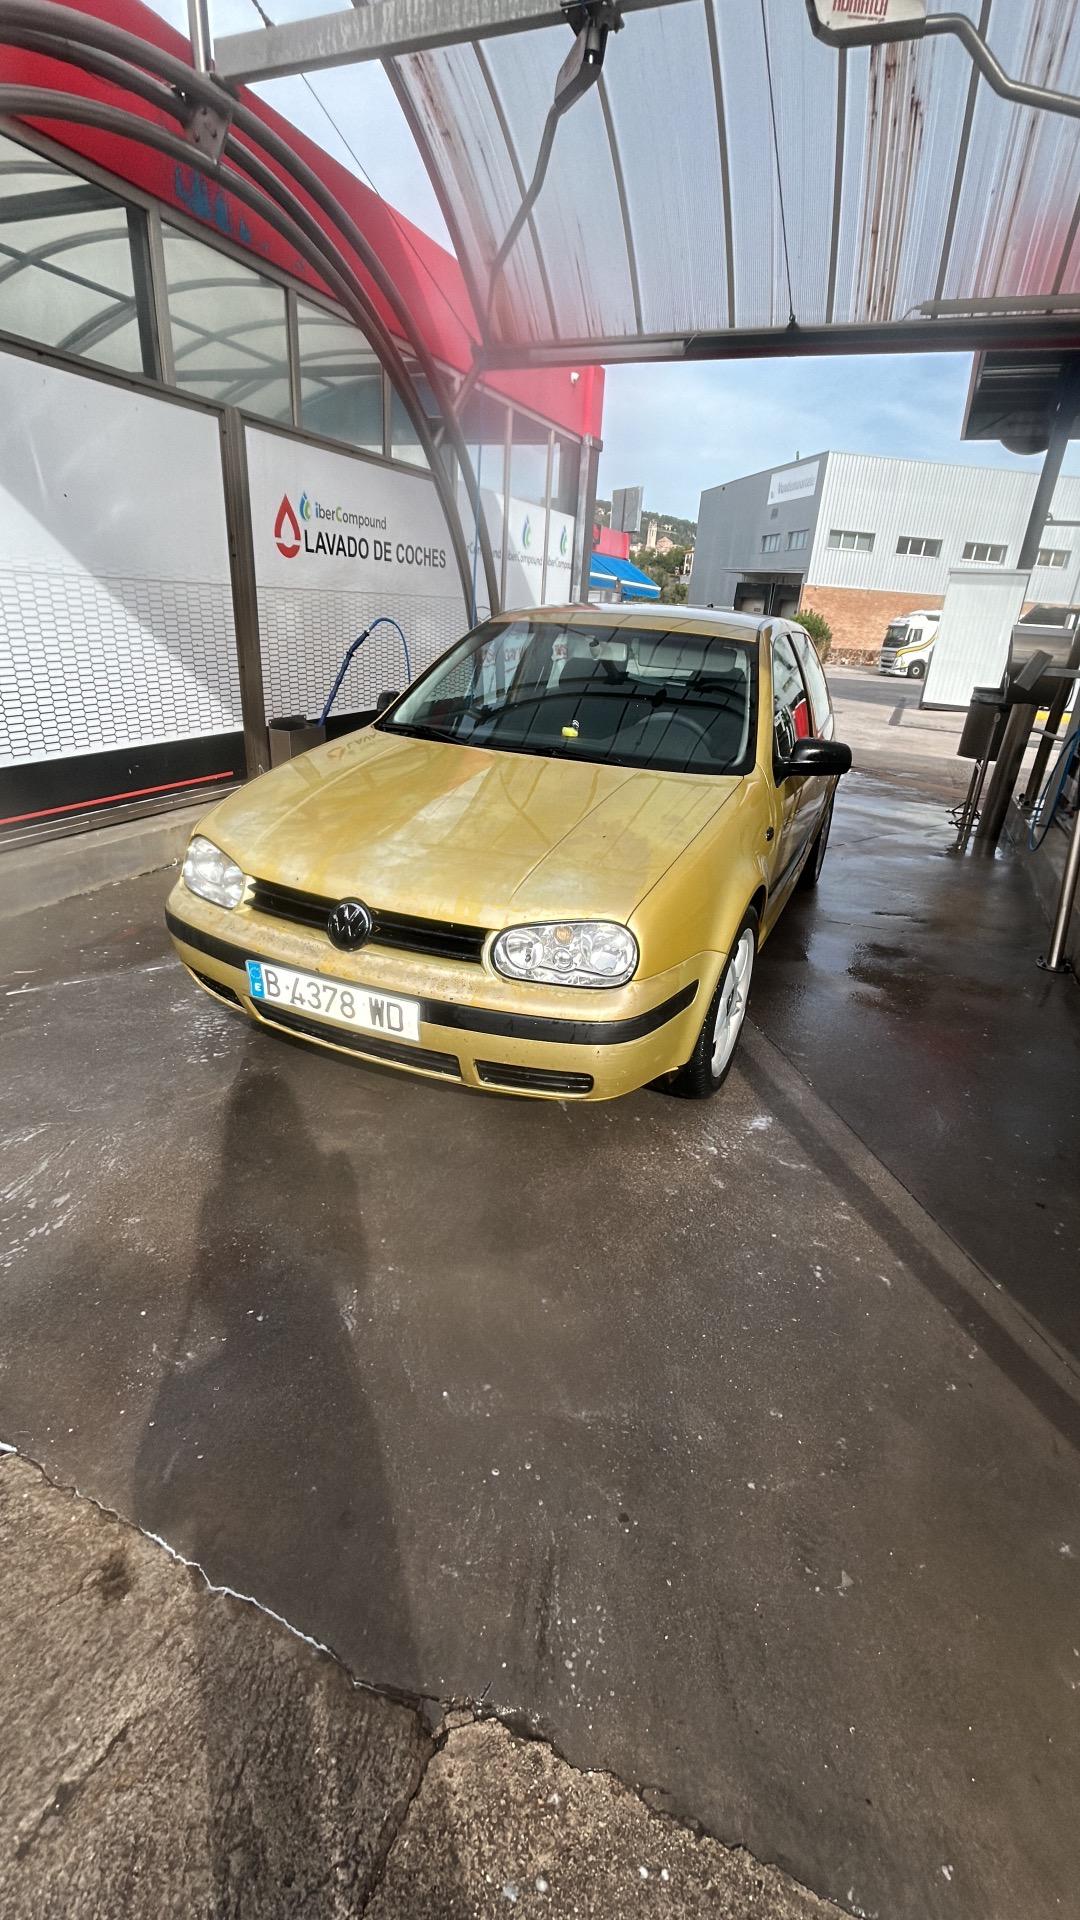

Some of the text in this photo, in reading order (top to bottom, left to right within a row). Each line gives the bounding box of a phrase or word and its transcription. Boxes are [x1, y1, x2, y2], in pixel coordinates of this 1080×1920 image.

[315, 502, 387, 530] iberCompound
[304, 529, 369, 559] LAVADO
[374, 539, 392, 562] DE
[396, 543, 446, 568] COCHES
[369, 996, 404, 1032] WD
